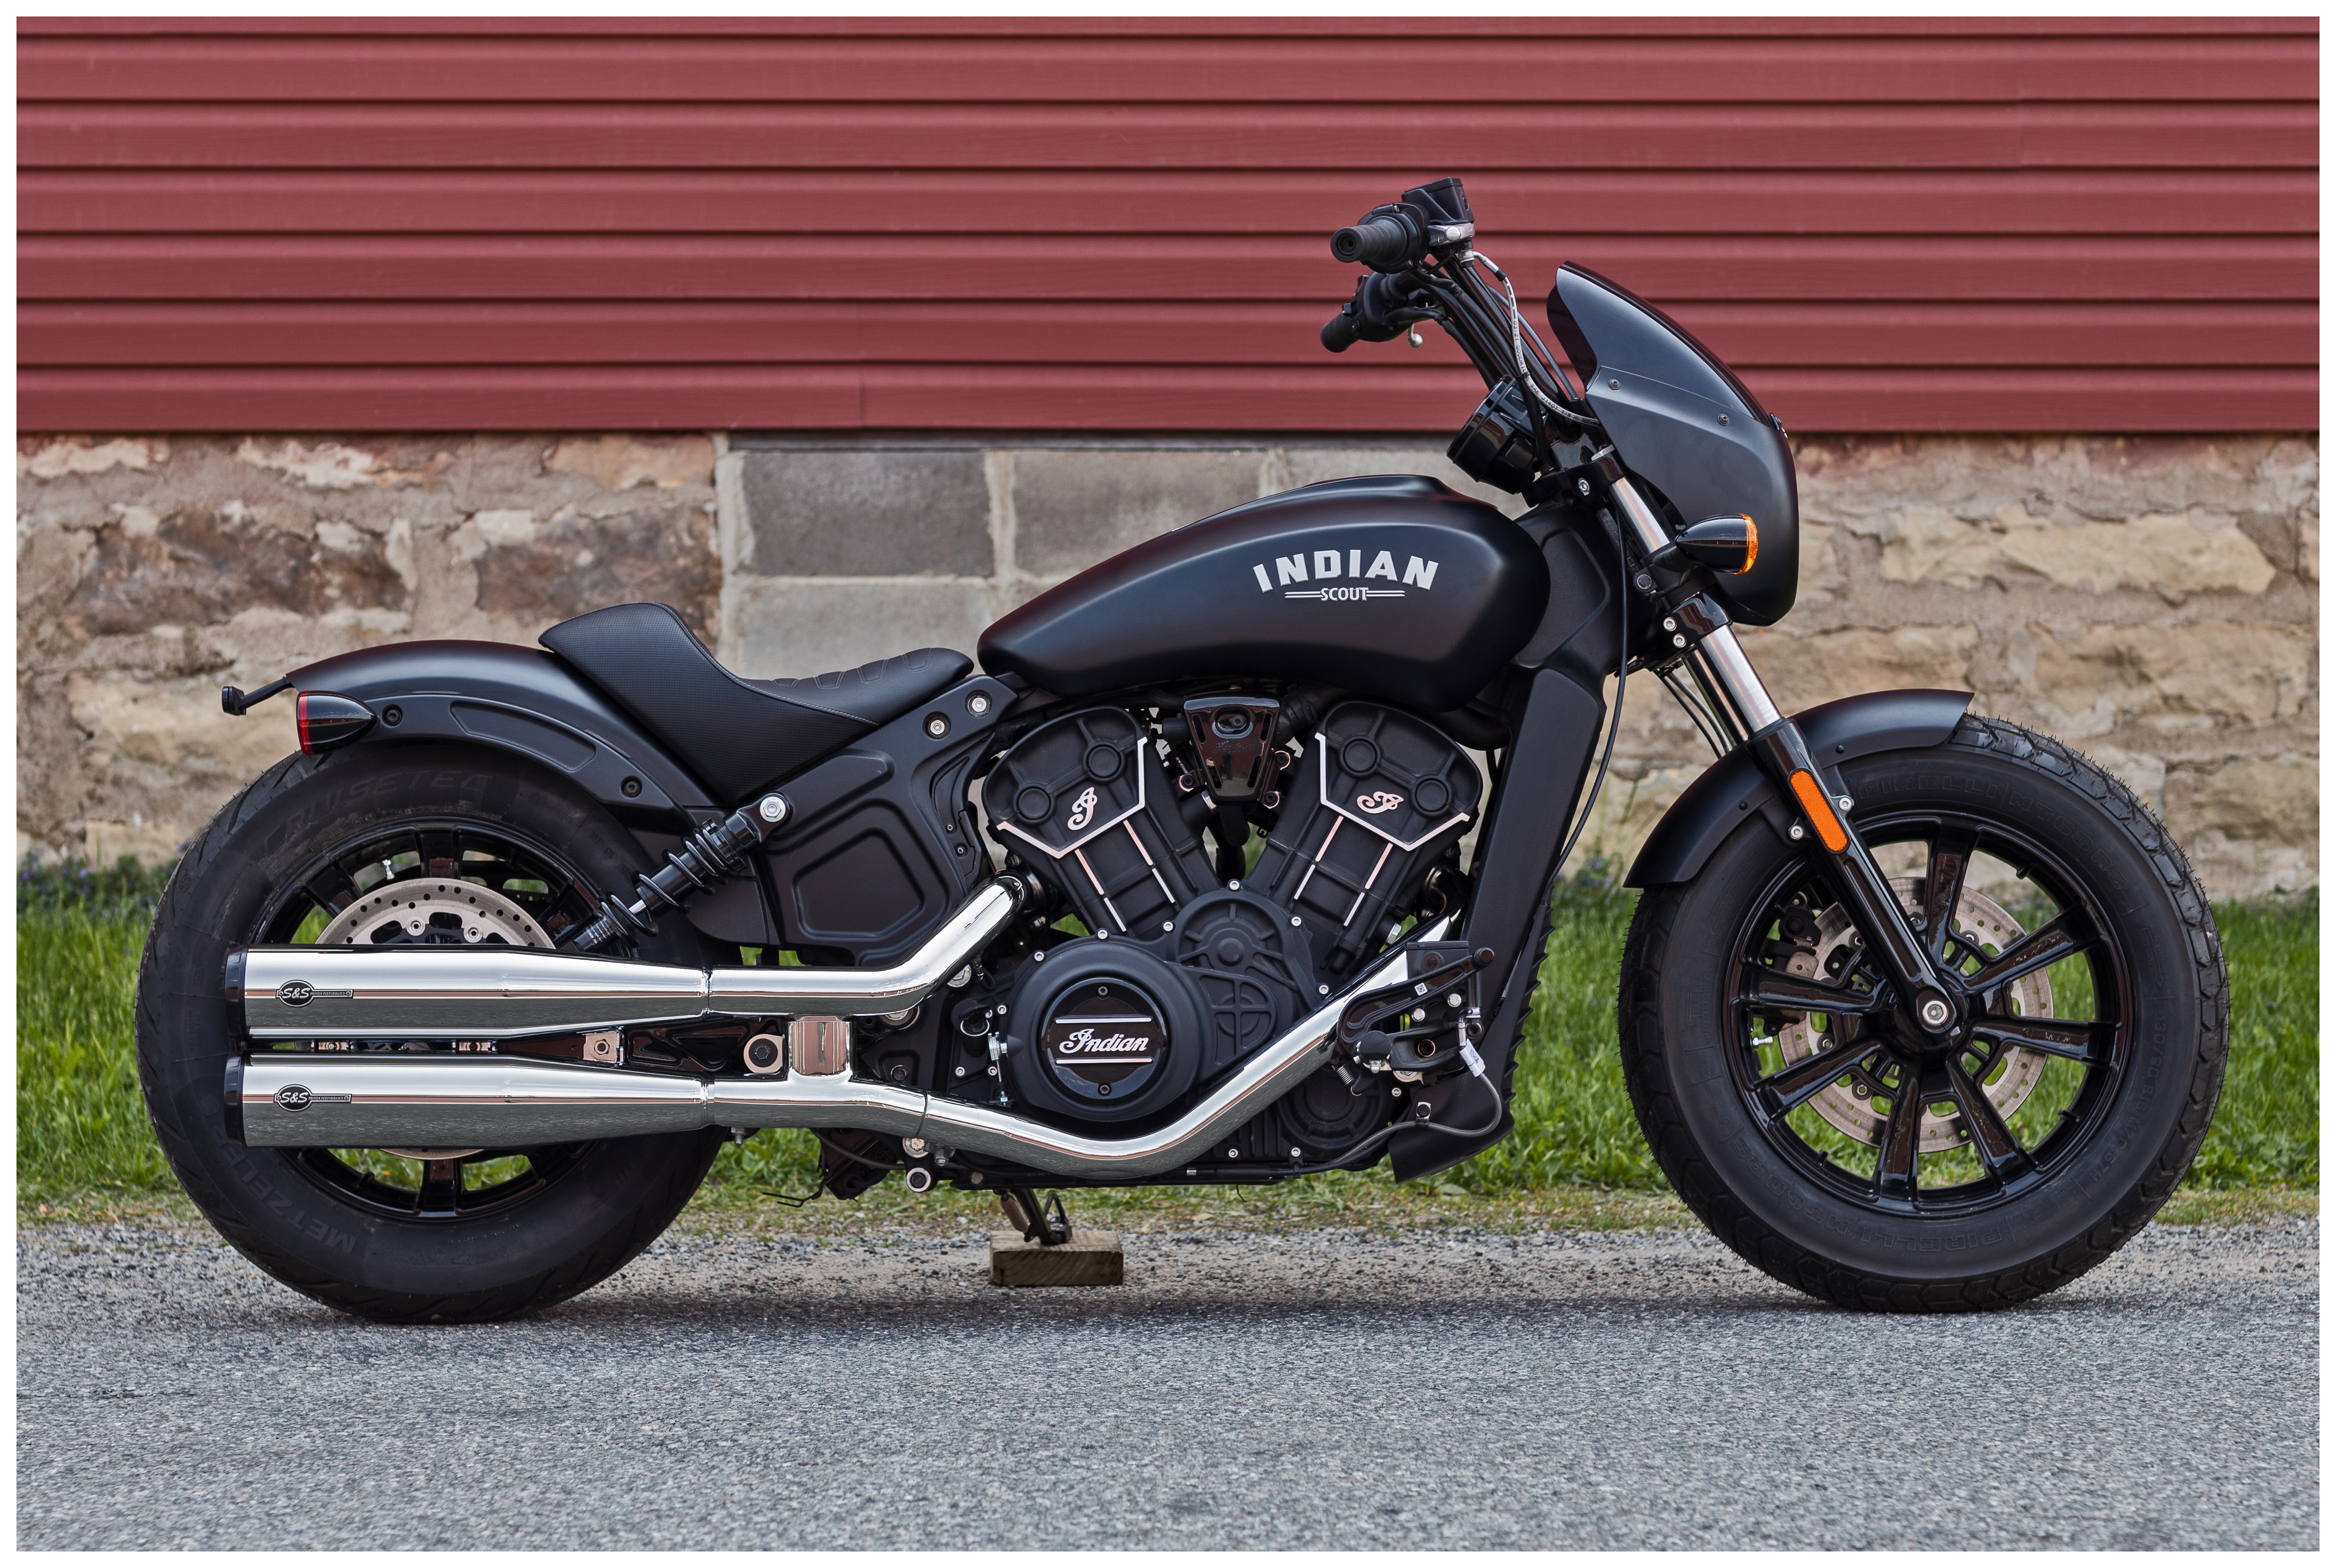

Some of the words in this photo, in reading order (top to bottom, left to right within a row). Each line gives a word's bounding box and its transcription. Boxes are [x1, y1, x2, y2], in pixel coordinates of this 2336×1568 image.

[1516, 345, 1530, 381] GOODRIDE
[1530, 384, 1539, 395] SAE
[1541, 397, 1558, 410] J1401
[1253, 549, 1439, 593] INDIAN
[1321, 587, 1369, 602] SCOUT
[262, 769, 493, 851] CRUISETEC
[1857, 775, 1999, 800] PIRELLI
[2009, 790, 2094, 852] MT60
[2090, 847, 2129, 890] RS
[282, 988, 310, 999] S&S
[1059, 1028, 1148, 1054] Indian
[280, 1092, 309, 1103] S&S
[1731, 1137, 1768, 1179] RS
[211, 1125, 357, 1255] METZELER
[1765, 1174, 1850, 1235] MT60
[1861, 1227, 2003, 1252] PIRELLI
